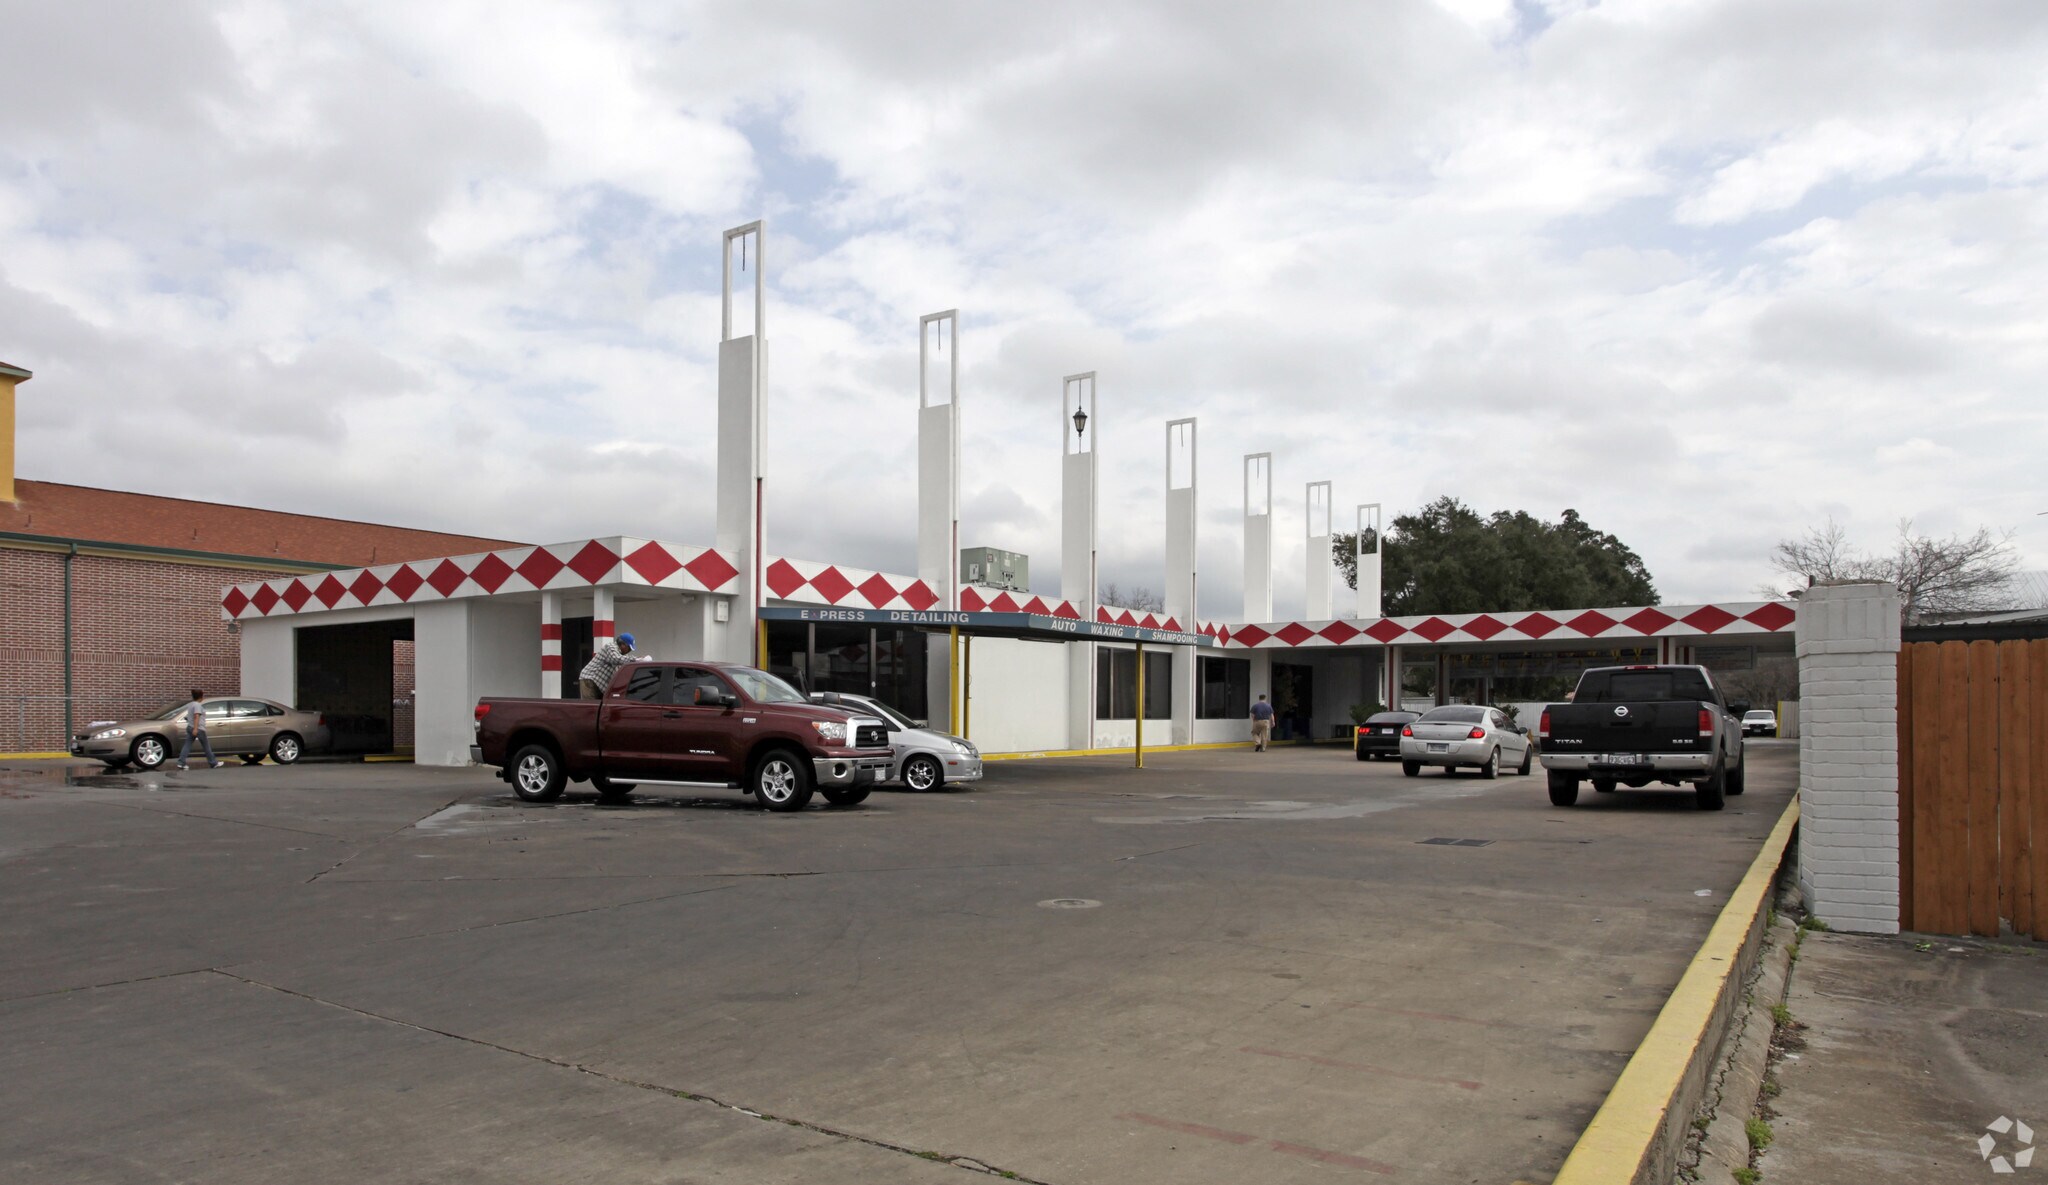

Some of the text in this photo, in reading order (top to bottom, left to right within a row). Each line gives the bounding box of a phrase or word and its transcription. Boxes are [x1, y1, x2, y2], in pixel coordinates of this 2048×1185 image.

[890, 611, 969, 623] DETAILING
[1051, 620, 1198, 644] AUTO WAXING & SHAMPOOING
